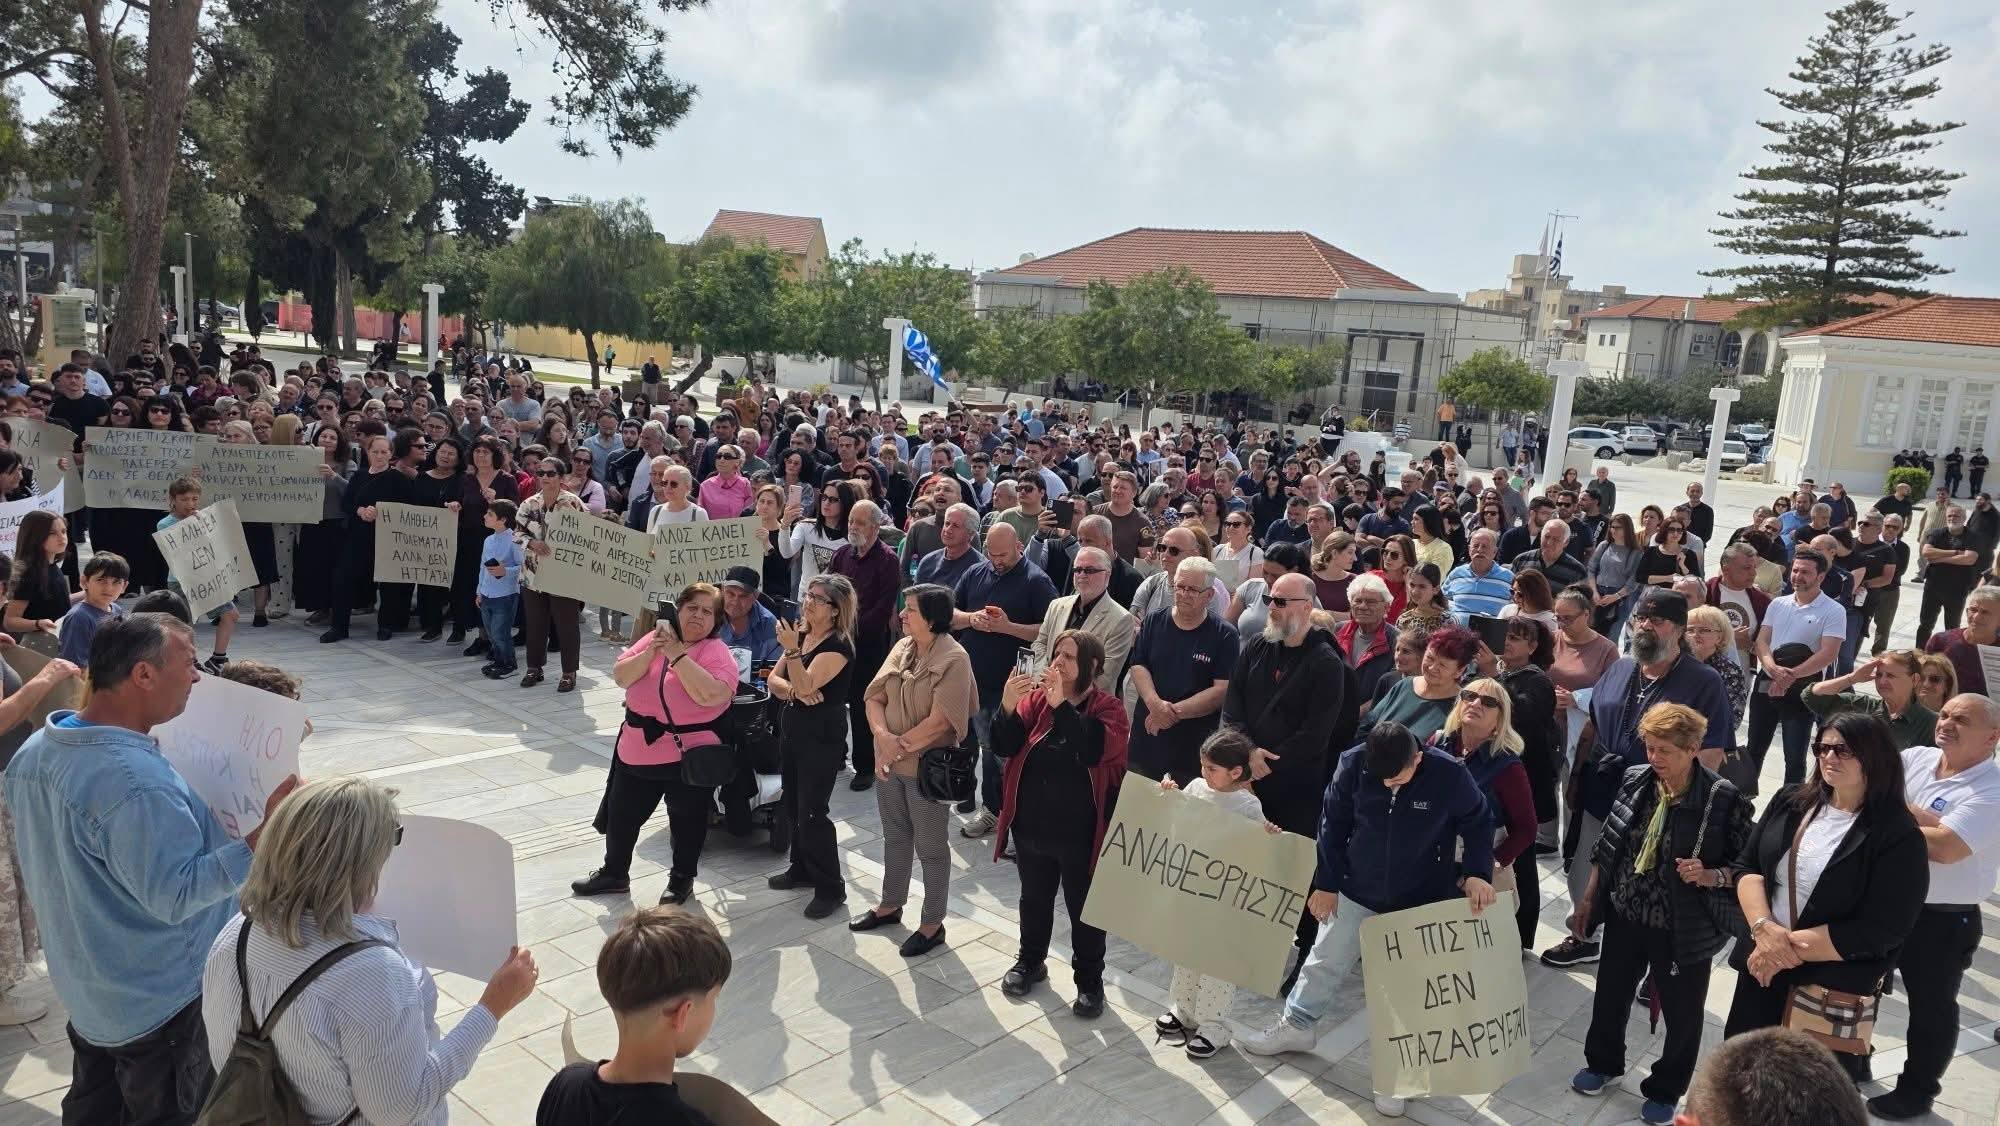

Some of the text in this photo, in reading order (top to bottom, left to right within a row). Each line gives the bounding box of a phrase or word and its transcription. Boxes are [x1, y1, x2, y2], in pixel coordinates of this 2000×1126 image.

[87, 469, 116, 480] ΔΕΝ
[124, 470, 139, 480] ΣΕ
[381, 508, 438, 530] Η ΑΛΗΘΕΙΑ
[561, 513, 627, 546] ΜΗ ΓΙΝΟΥ
[165, 533, 177, 550] Η
[391, 530, 449, 550] ΠΟΛΕΜΑΤΑΙ
[701, 522, 746, 542] ΚΑΝΕΙ
[191, 542, 216, 570] ΔΕΝ
[392, 549, 449, 567] ΑΛΛΑ ΔΕΝ
[548, 528, 653, 575] ΚΟΙΝΩΝΟΣ ΑΙΡΕΣΕΩΣ
[669, 543, 751, 565] ΕΚΠΤΩΣΕΙΣ
[554, 547, 648, 592] ΕΣΤΩ ΚΑΙ ΣΙΩΠΩΝ
[663, 568, 731, 588] ΚΑΙ ΑΛΛΟ
[647, 591, 681, 604] ΕΓΙΝ
[1100, 821, 1305, 930] ΑΝΑΘΕΩΡΗΣΤΕ
[1384, 918, 1494, 961] Η ΠΙΣΤΗ
[1423, 970, 1477, 1010] ΔΕΝ
[1388, 1004, 1527, 1070] ΠΑΖΑΡΕΥΕΤΑΙ
